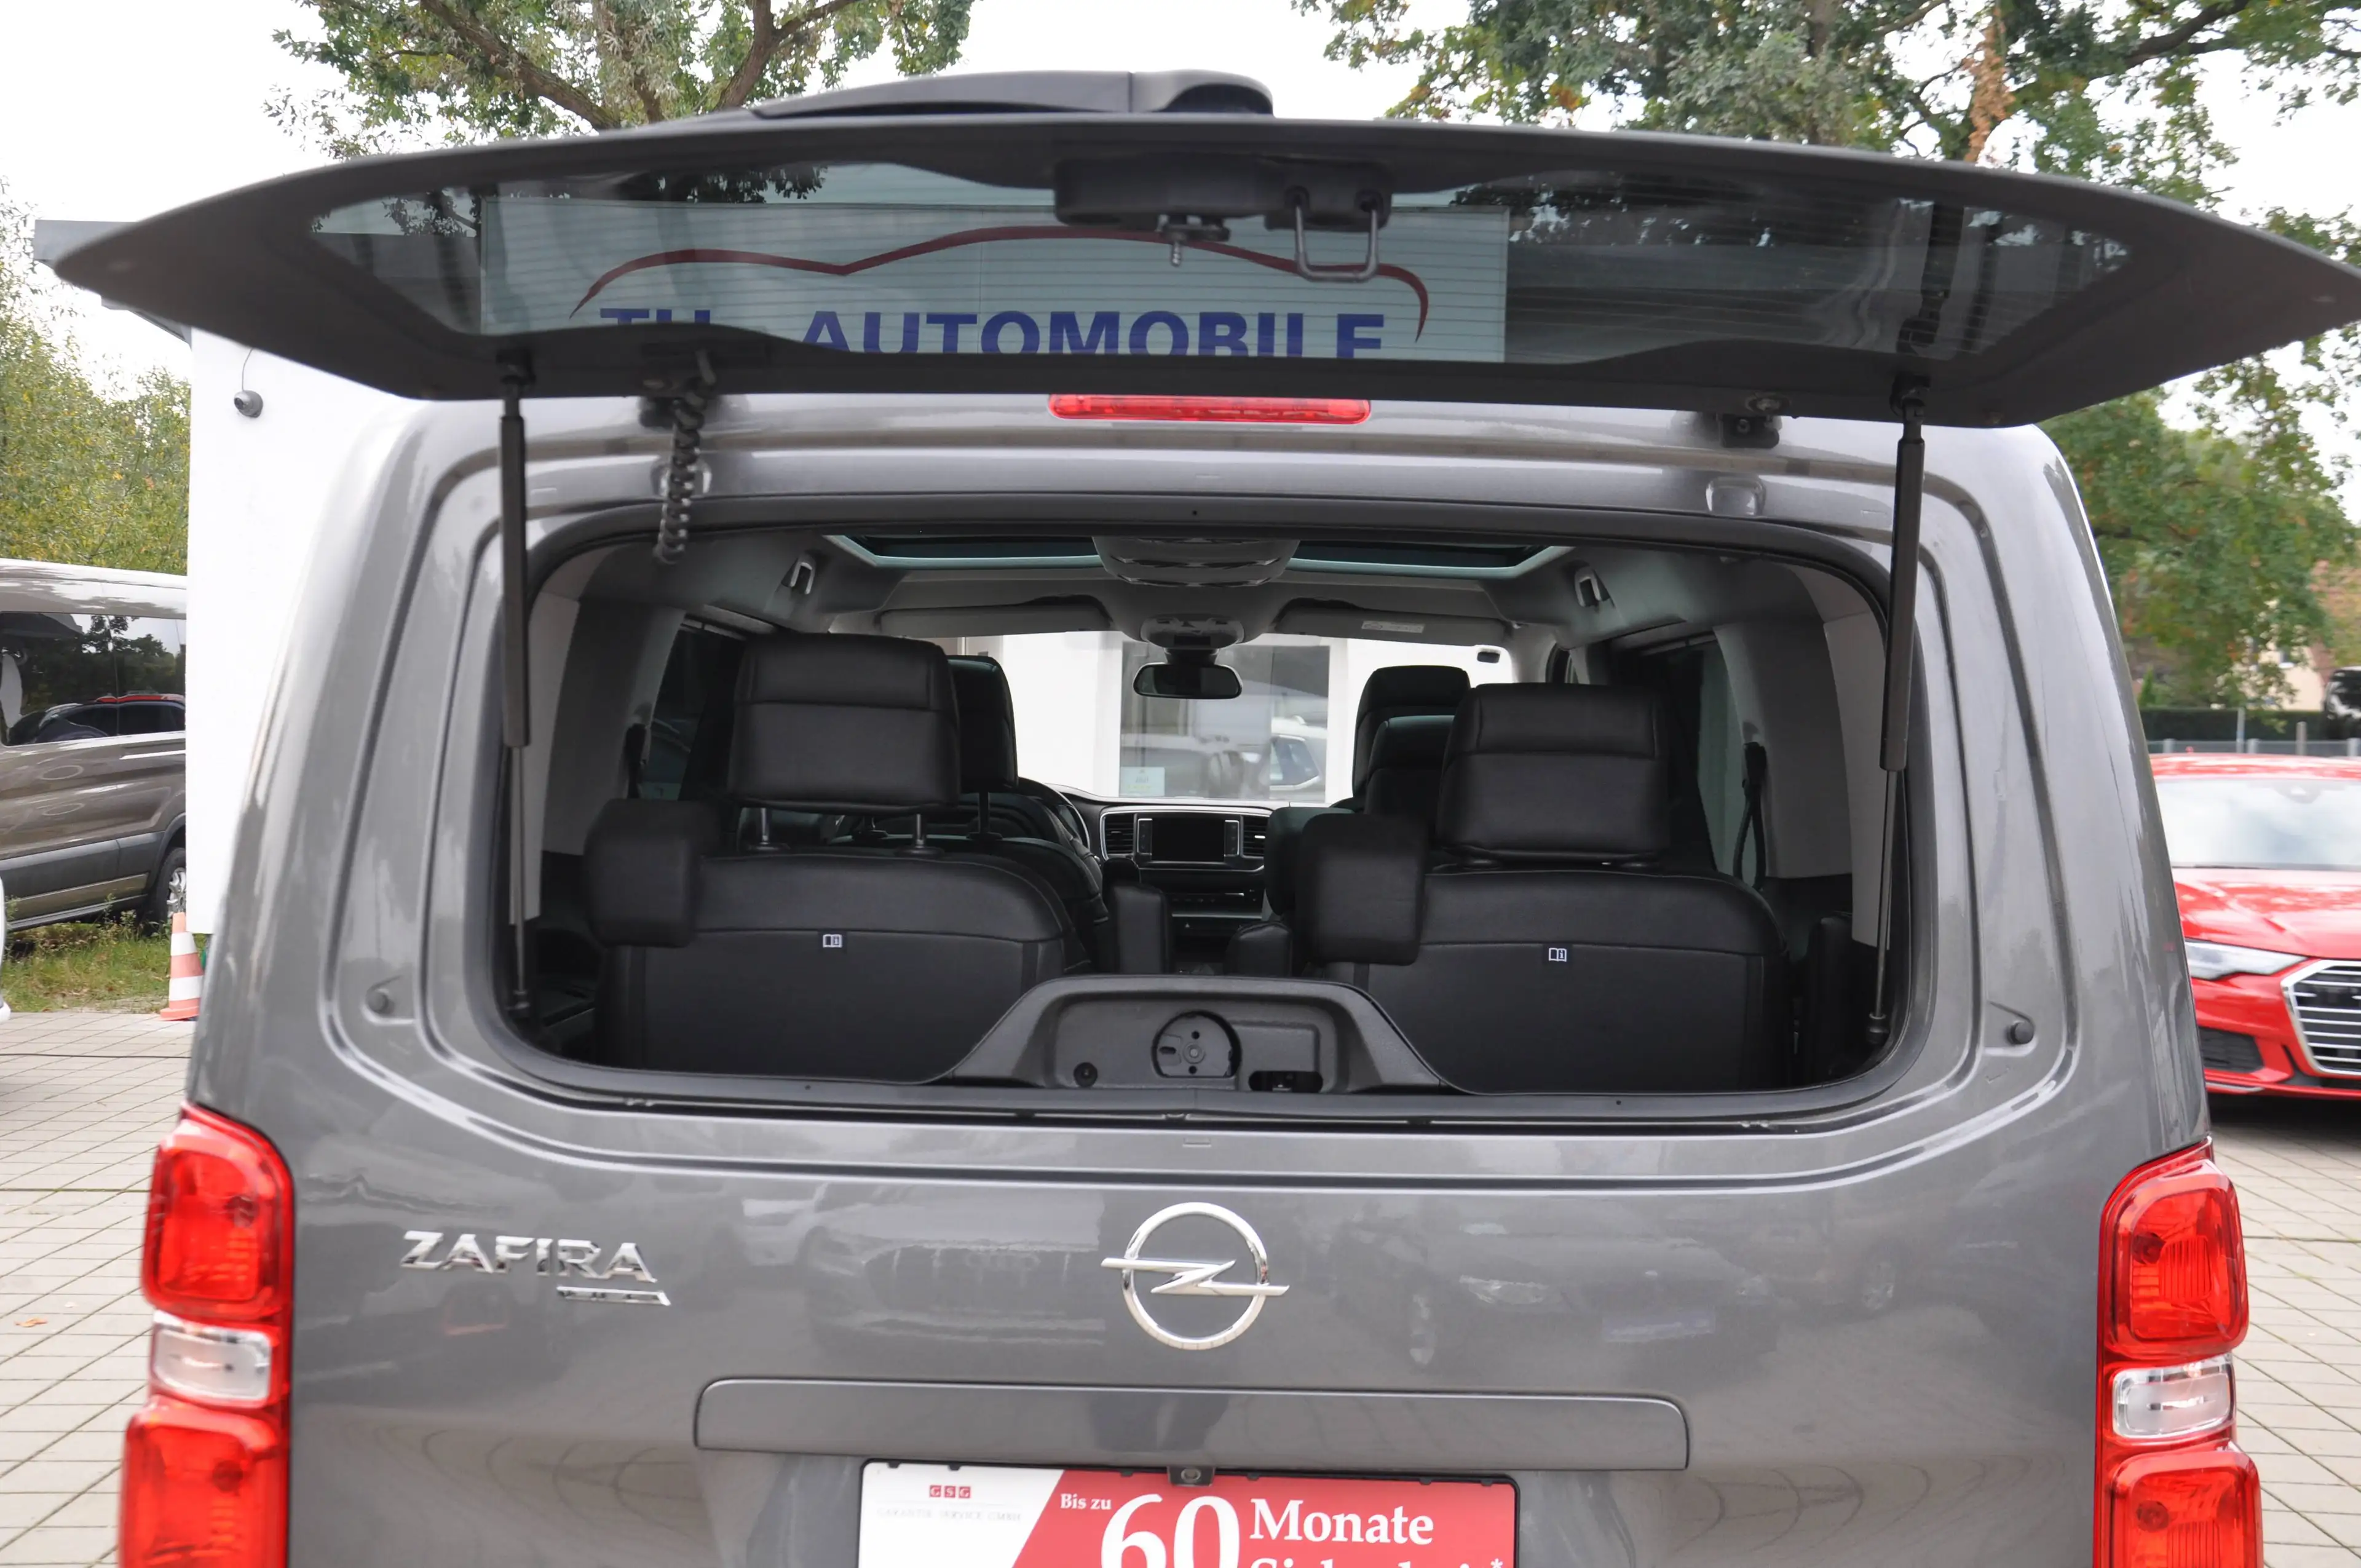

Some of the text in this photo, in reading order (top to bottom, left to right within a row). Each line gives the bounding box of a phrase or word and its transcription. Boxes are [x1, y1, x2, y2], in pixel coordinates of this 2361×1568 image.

[400, 1230, 658, 1283] ZAFIRA
[929, 1485, 971, 1499] GSG
[1061, 1494, 1112, 1510] Bis zu
[1101, 1494, 1434, 1568] 60 Monate
